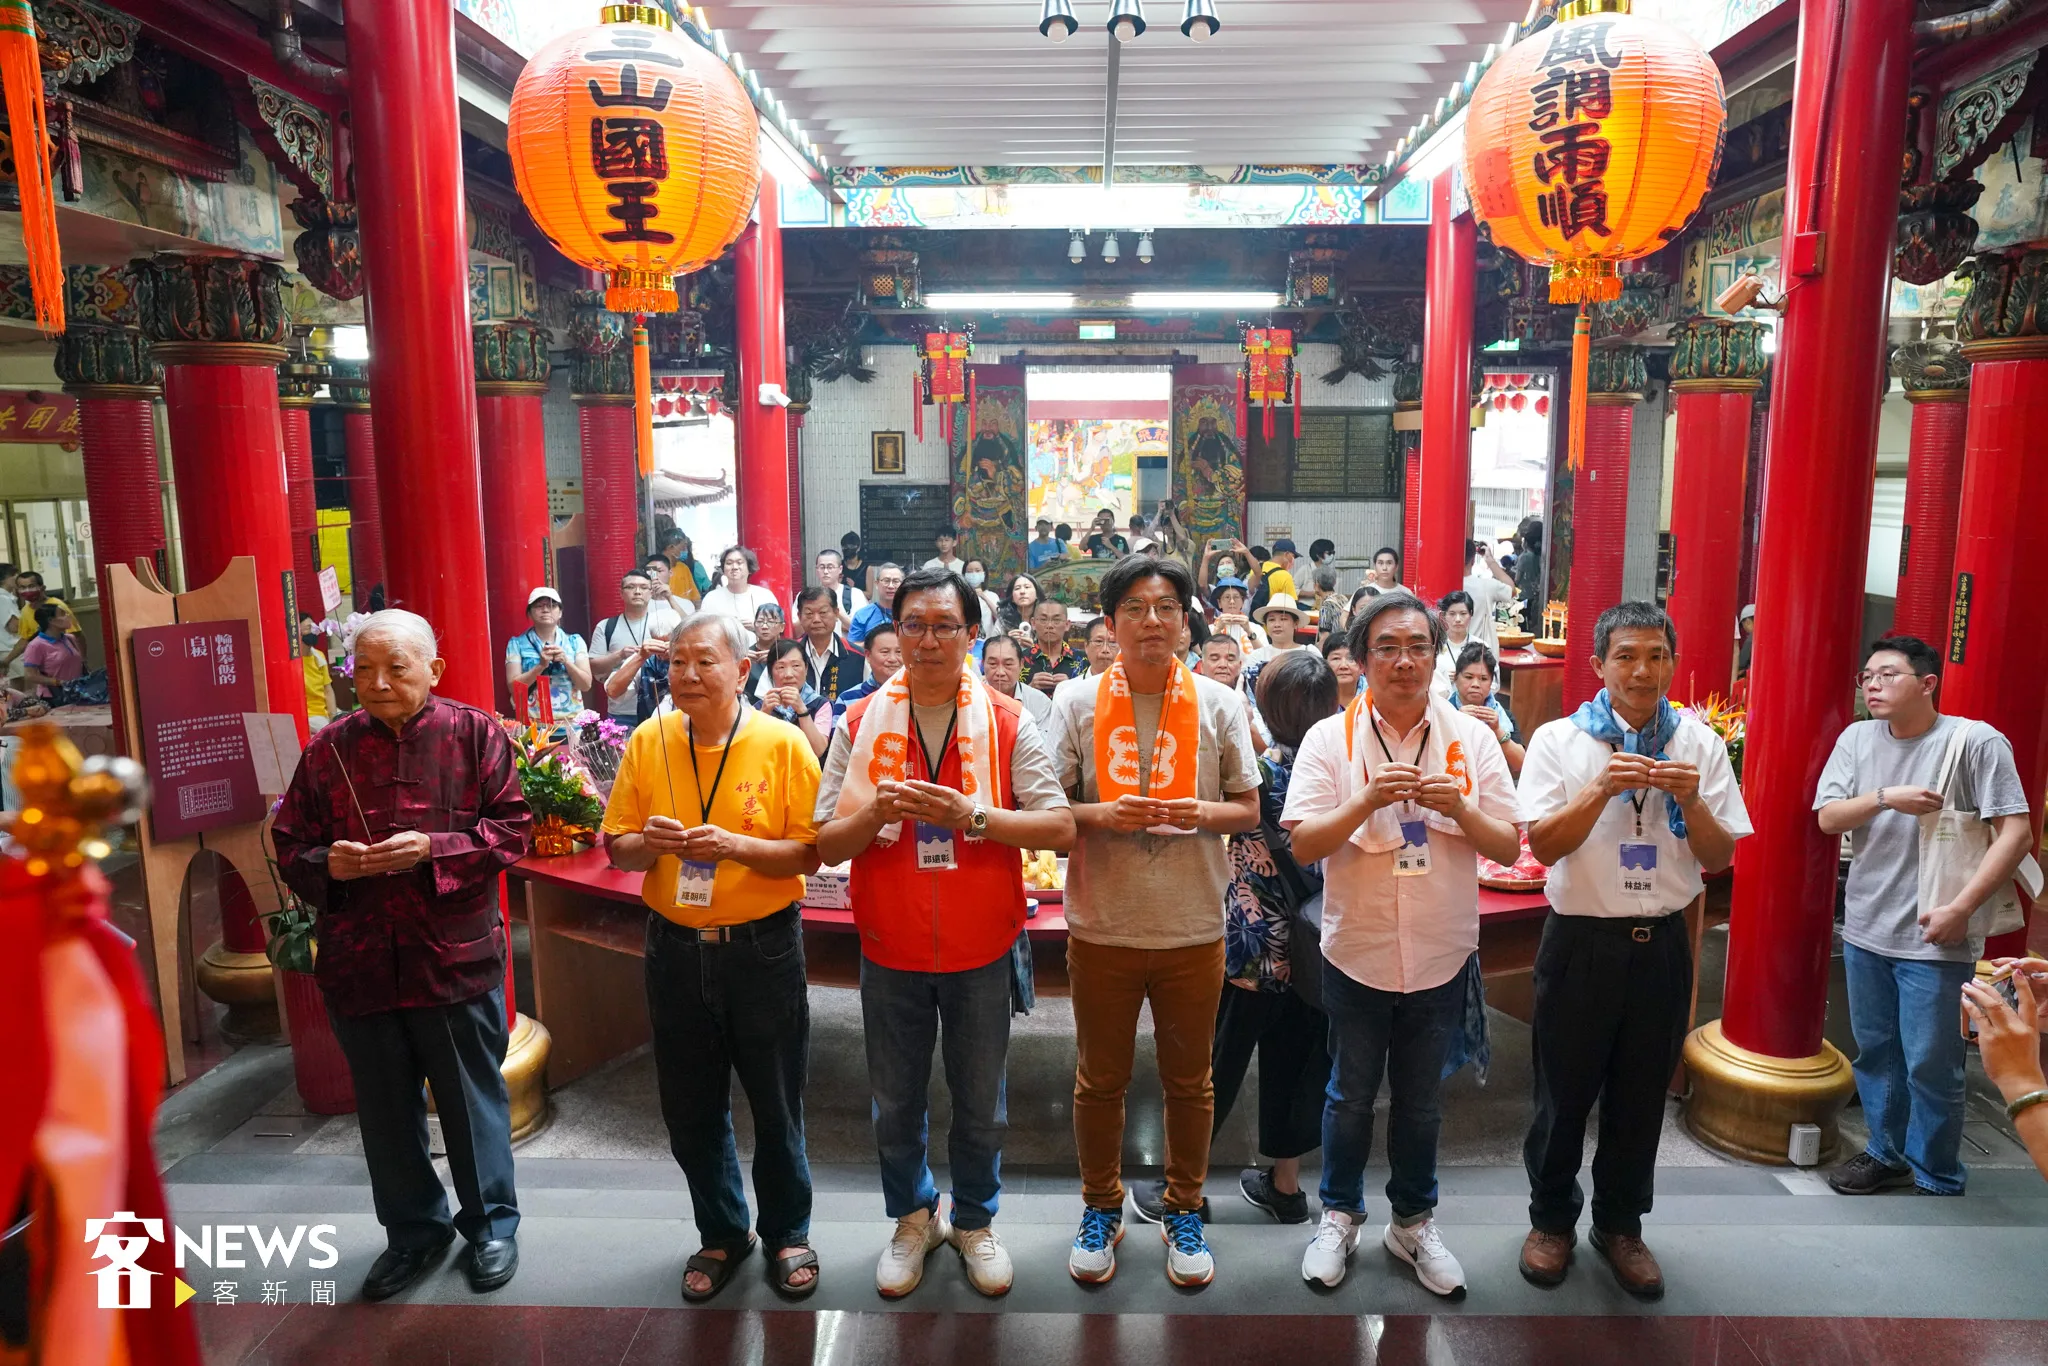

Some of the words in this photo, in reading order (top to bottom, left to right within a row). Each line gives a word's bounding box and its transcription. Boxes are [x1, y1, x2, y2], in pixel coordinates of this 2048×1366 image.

[584, 29, 684, 244] 三山國王
[1529, 22, 1623, 241] 風調雨順
[190, 636, 208, 658] 白板
[215, 633, 236, 685] 輪值奉飯的
[1624, 881, 1652, 891] 林益洲
